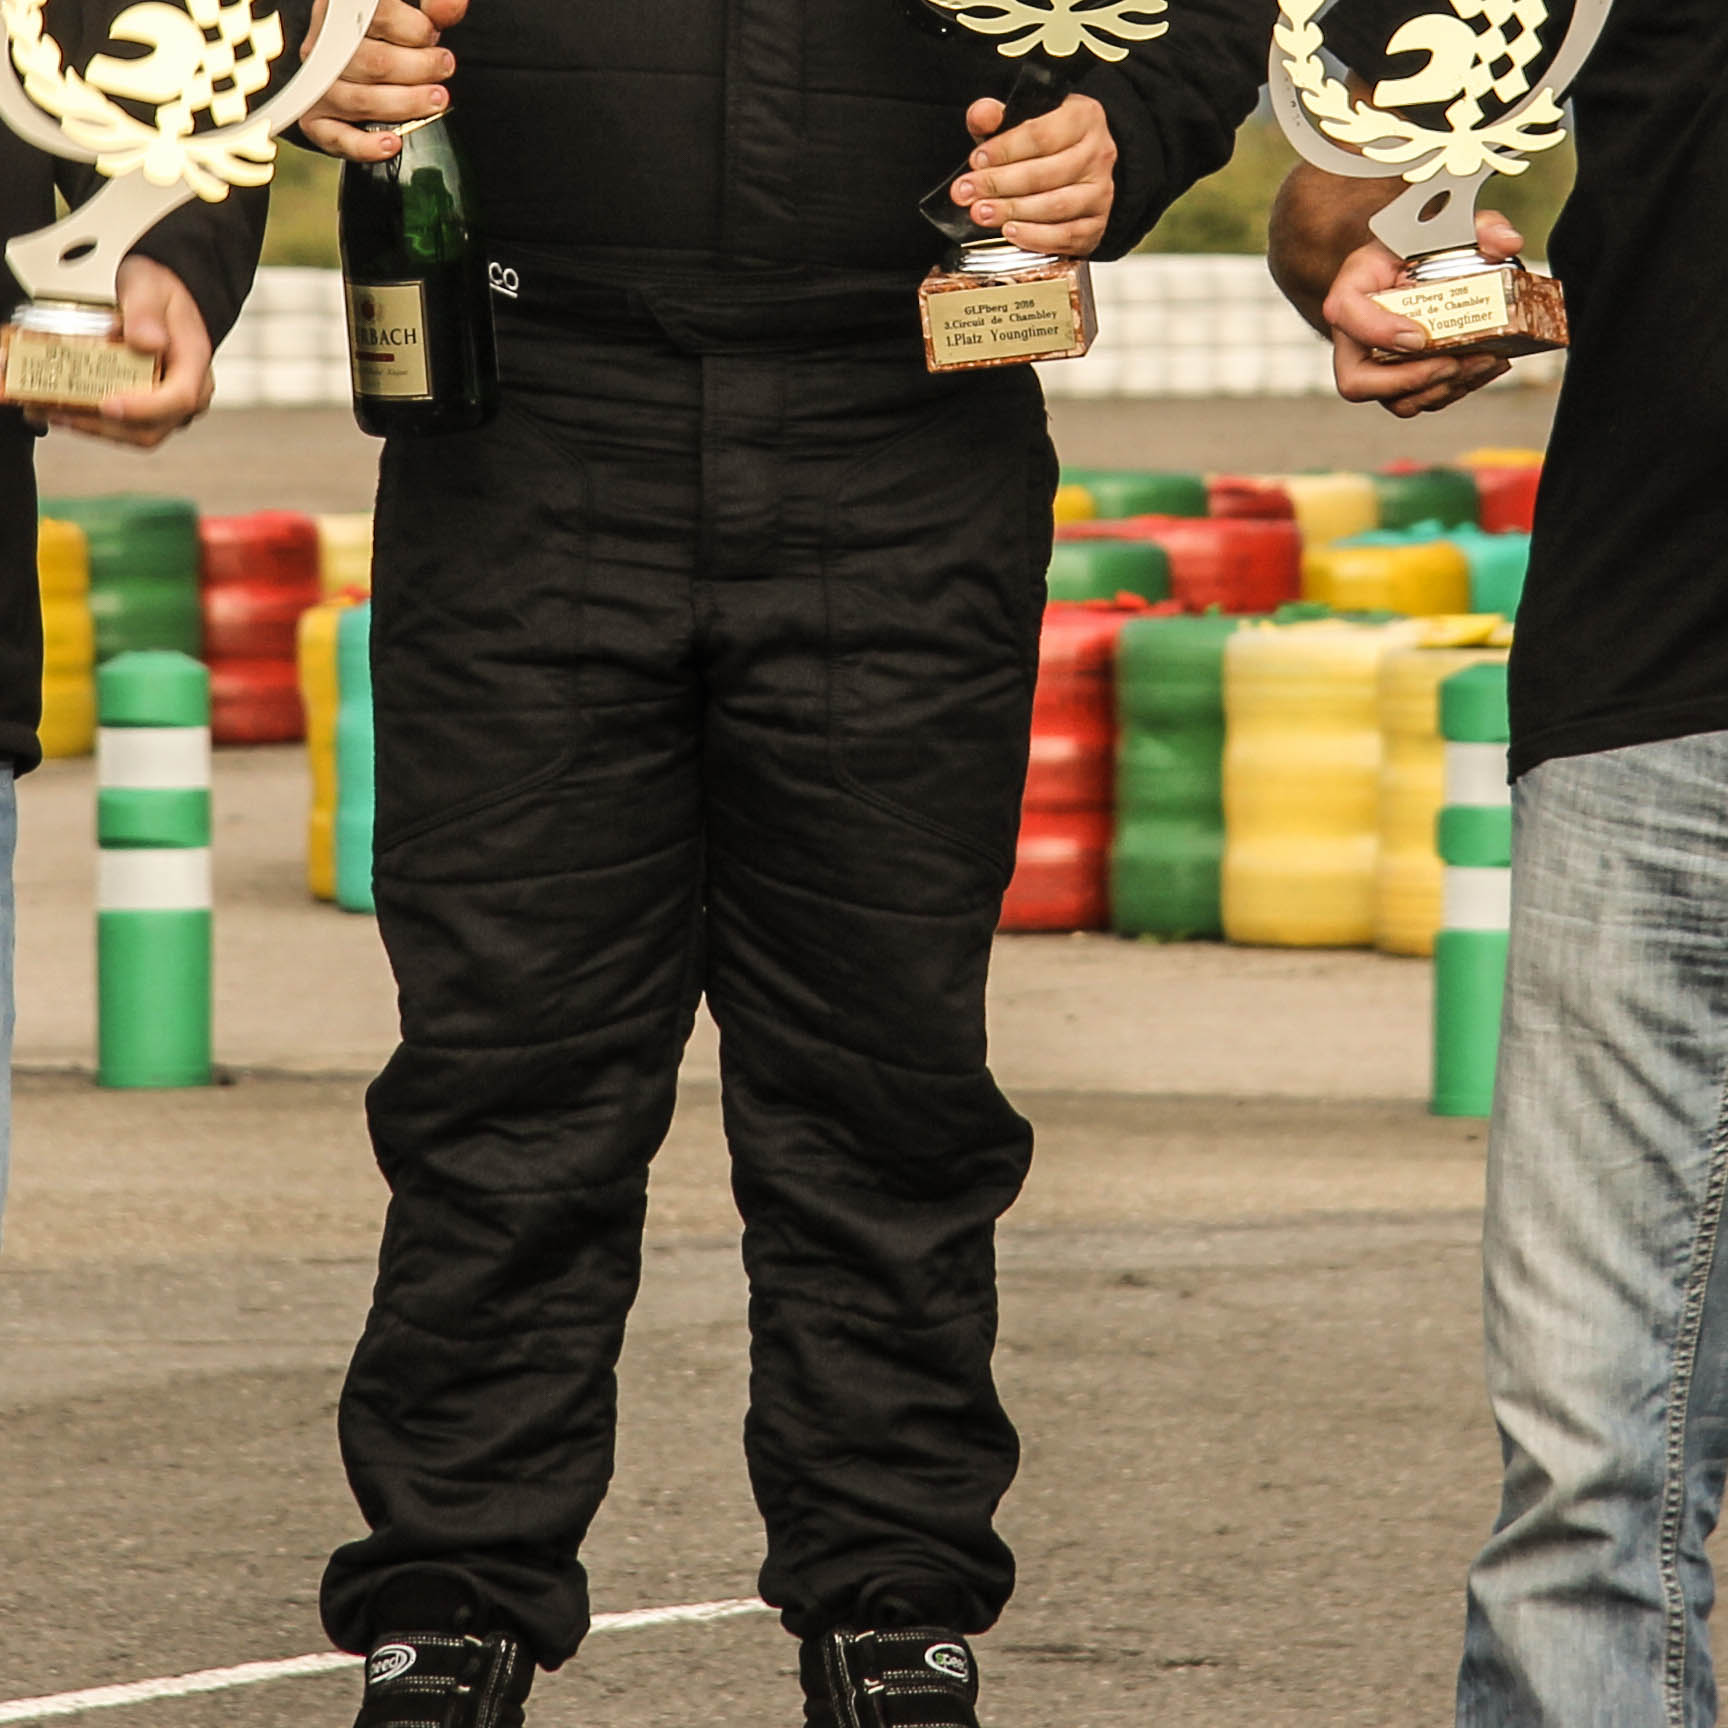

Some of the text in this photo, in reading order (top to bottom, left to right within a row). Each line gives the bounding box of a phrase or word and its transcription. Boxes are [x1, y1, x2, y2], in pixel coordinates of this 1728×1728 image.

[964, 303, 1008, 316] GLPberg
[991, 315, 1003, 324] de
[1009, 310, 1058, 323] Chambley
[1428, 310, 1493, 332] Youngtimer
[946, 325, 1059, 348] 1.Platz Youngtimer
